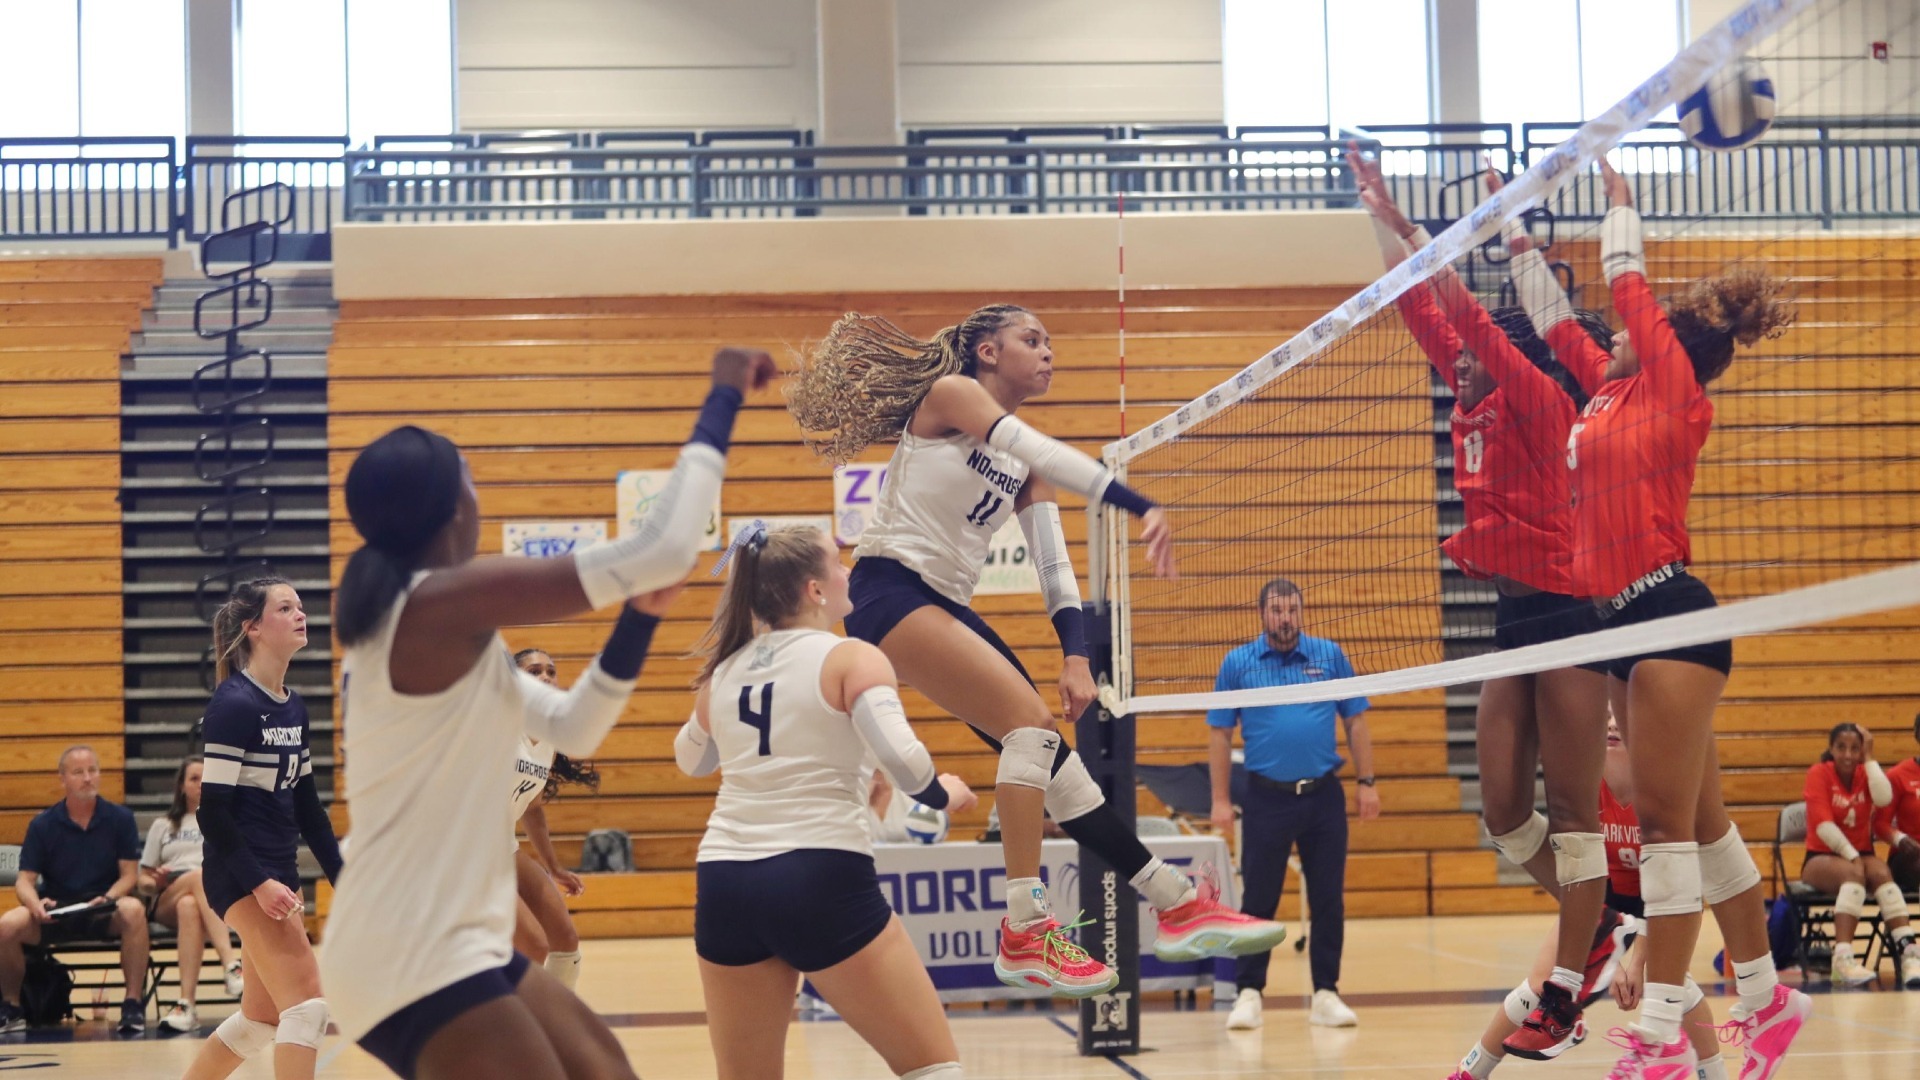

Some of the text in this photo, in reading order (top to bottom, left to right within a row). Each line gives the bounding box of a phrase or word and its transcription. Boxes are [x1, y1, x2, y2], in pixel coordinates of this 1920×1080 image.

[966, 490, 1004, 526] 11
[738, 681, 775, 757] 4
[1618, 847, 1641, 869] 9
[1102, 870, 1120, 975] sports impor
